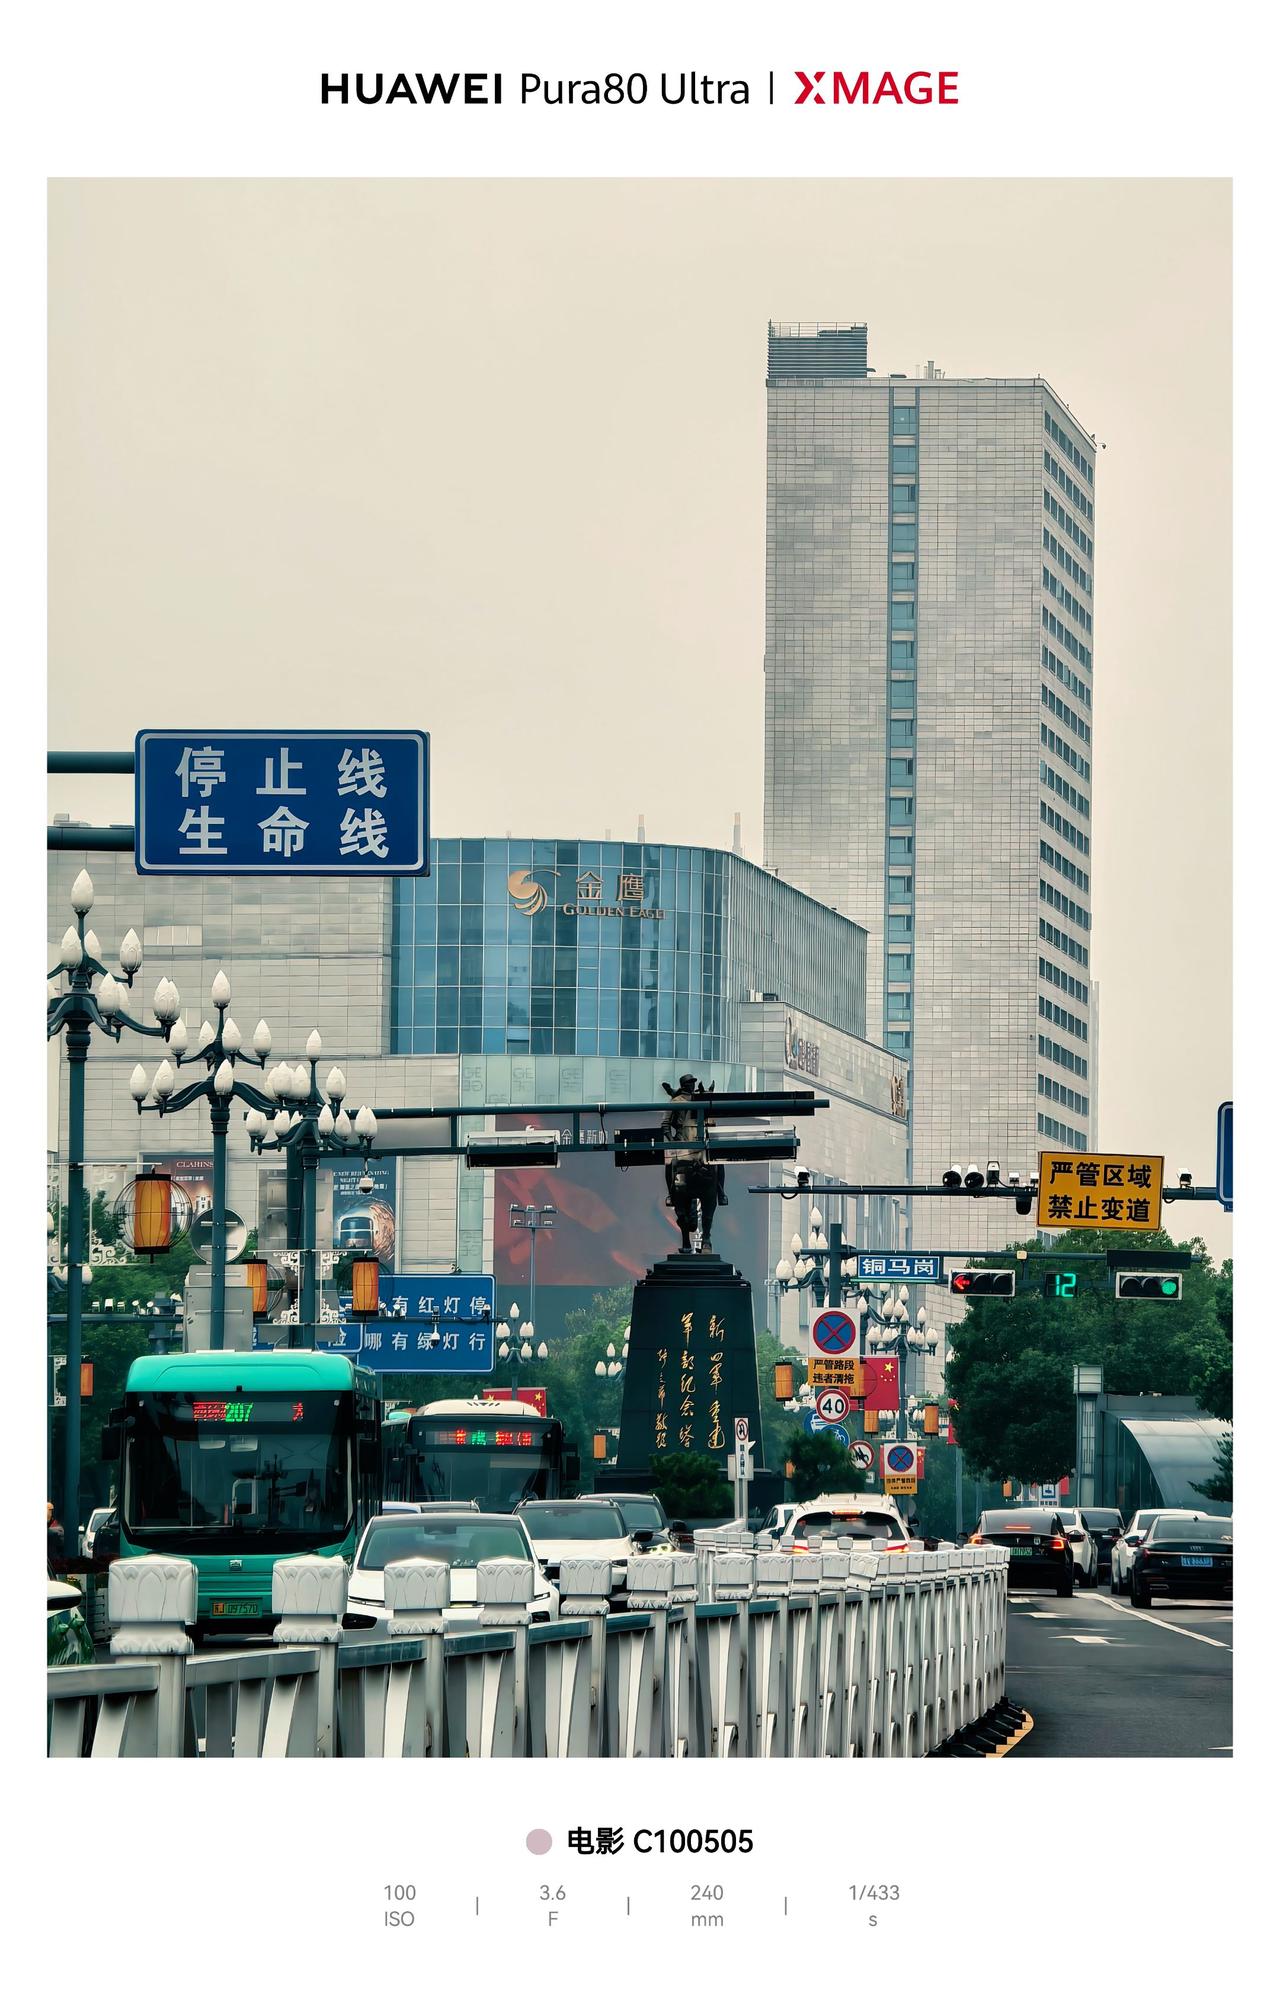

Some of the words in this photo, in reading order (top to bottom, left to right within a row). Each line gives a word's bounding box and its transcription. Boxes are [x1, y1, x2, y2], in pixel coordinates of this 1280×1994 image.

[175, 746, 387, 798] 停止线
[178, 805, 389, 858] 生命线
[576, 871, 645, 901] 金鹰
[562, 903, 625, 917] GOLDEN
[1050, 1161, 1152, 1189] 严管区域
[1048, 1194, 1150, 1222] 禁止变道
[862, 1259, 933, 1275] 铜马岗
[1055, 1273, 1077, 1298] 12
[378, 1296, 488, 1316] 有红灯停
[364, 1331, 485, 1351] 哪有绿灯行
[813, 1360, 854, 1371] 严管路段
[225, 1402, 253, 1422] 207
[822, 1398, 845, 1414] 40
